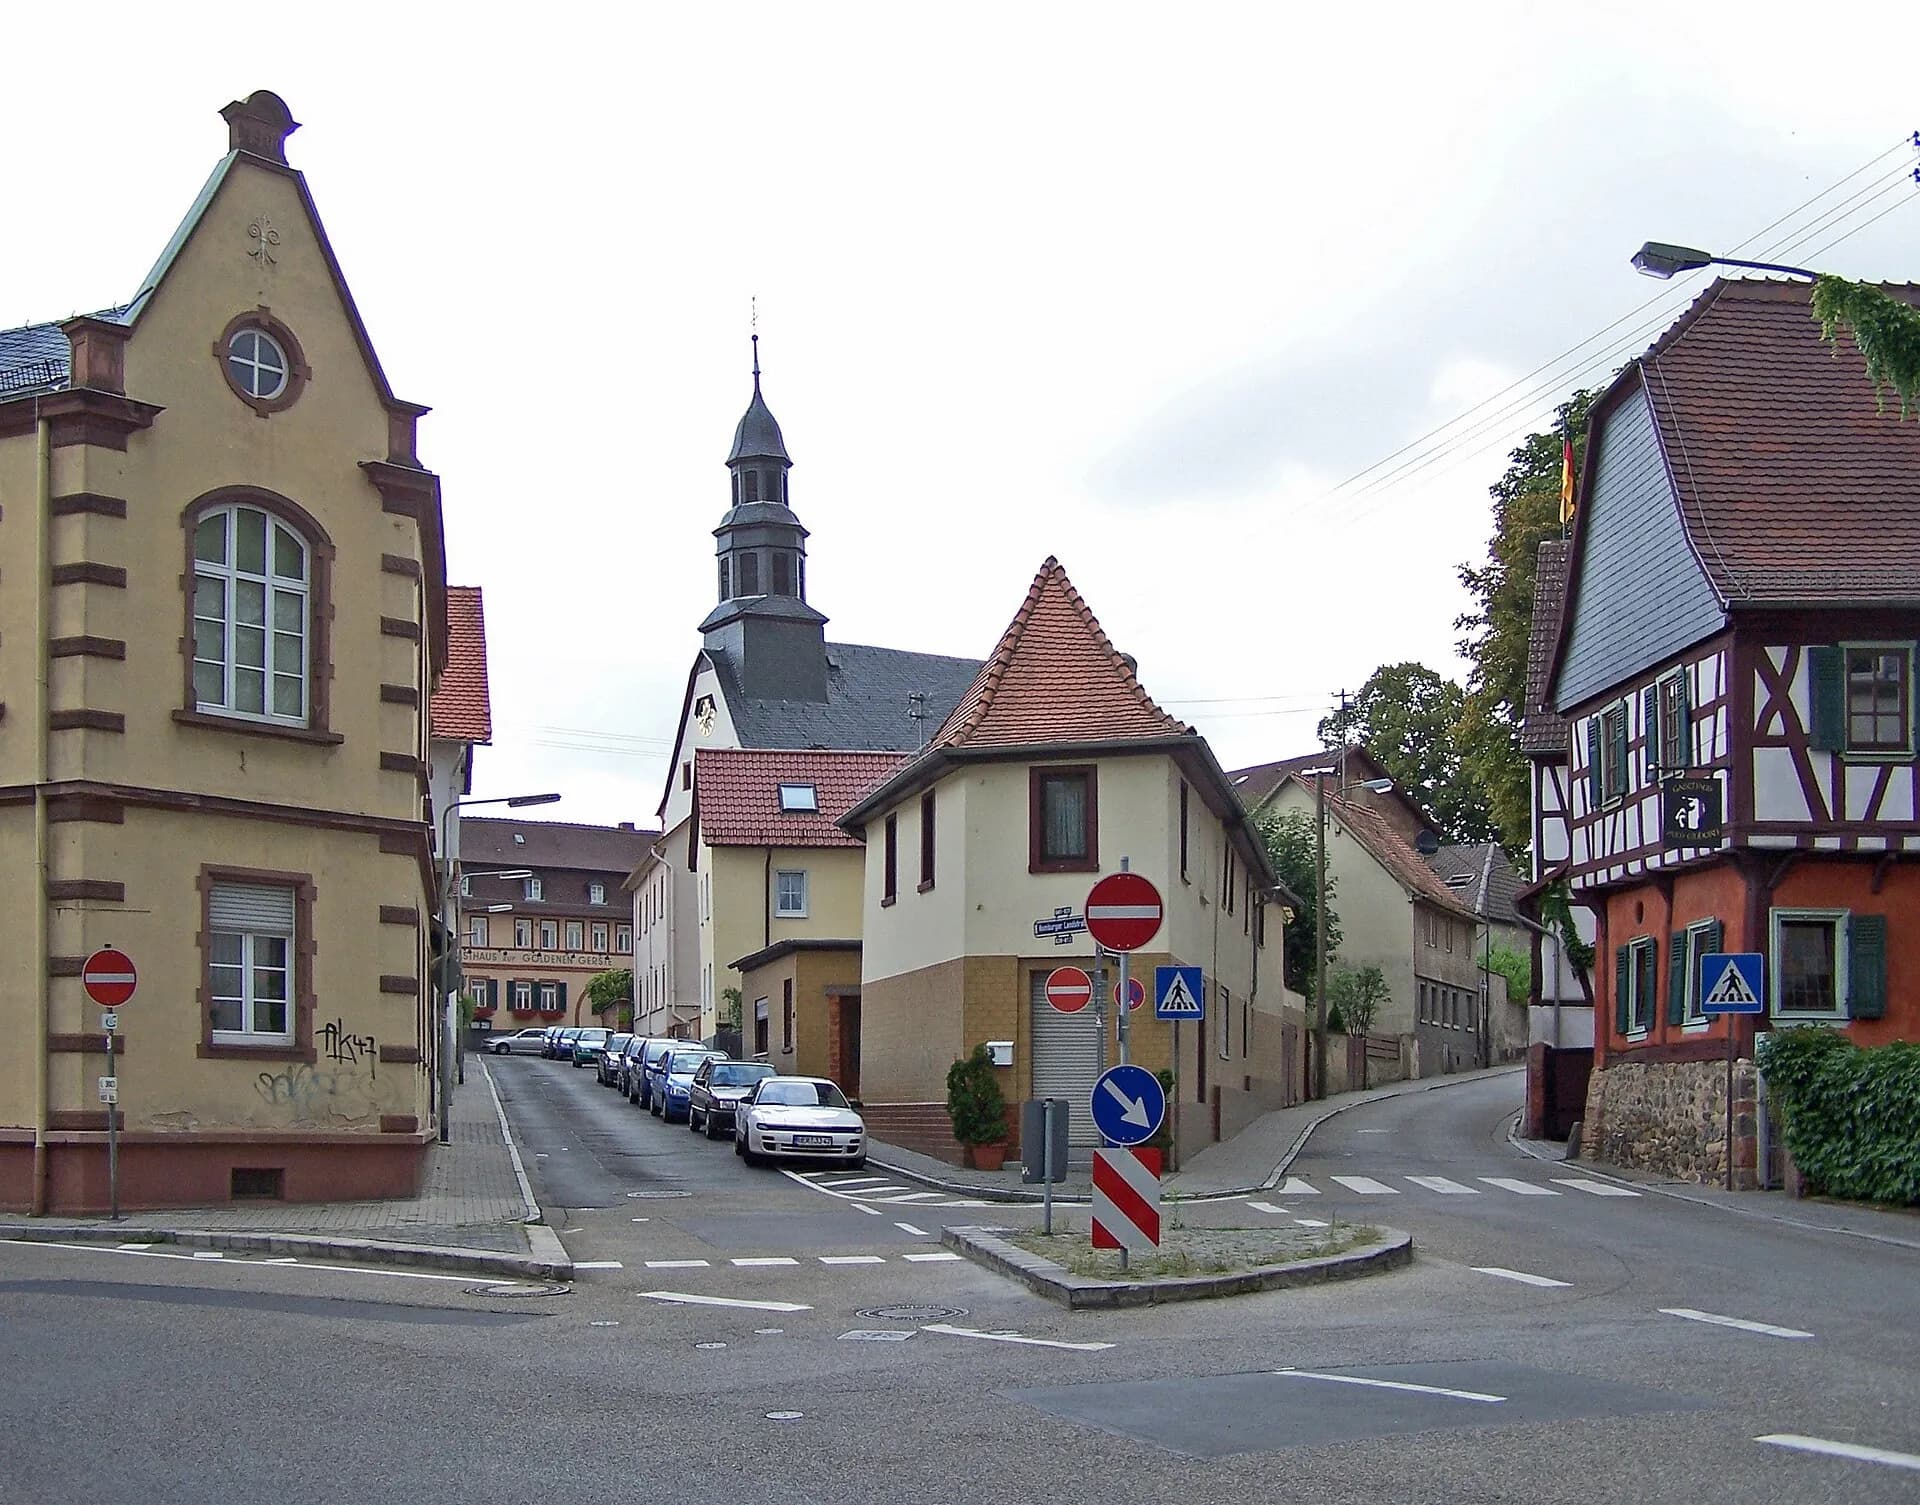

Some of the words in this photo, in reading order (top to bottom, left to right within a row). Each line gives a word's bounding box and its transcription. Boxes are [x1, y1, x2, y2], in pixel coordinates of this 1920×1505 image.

[463, 951, 497, 961] STHAUS
[522, 953, 573, 965] GOLDENEN
[578, 956, 613, 966] GERSTE
